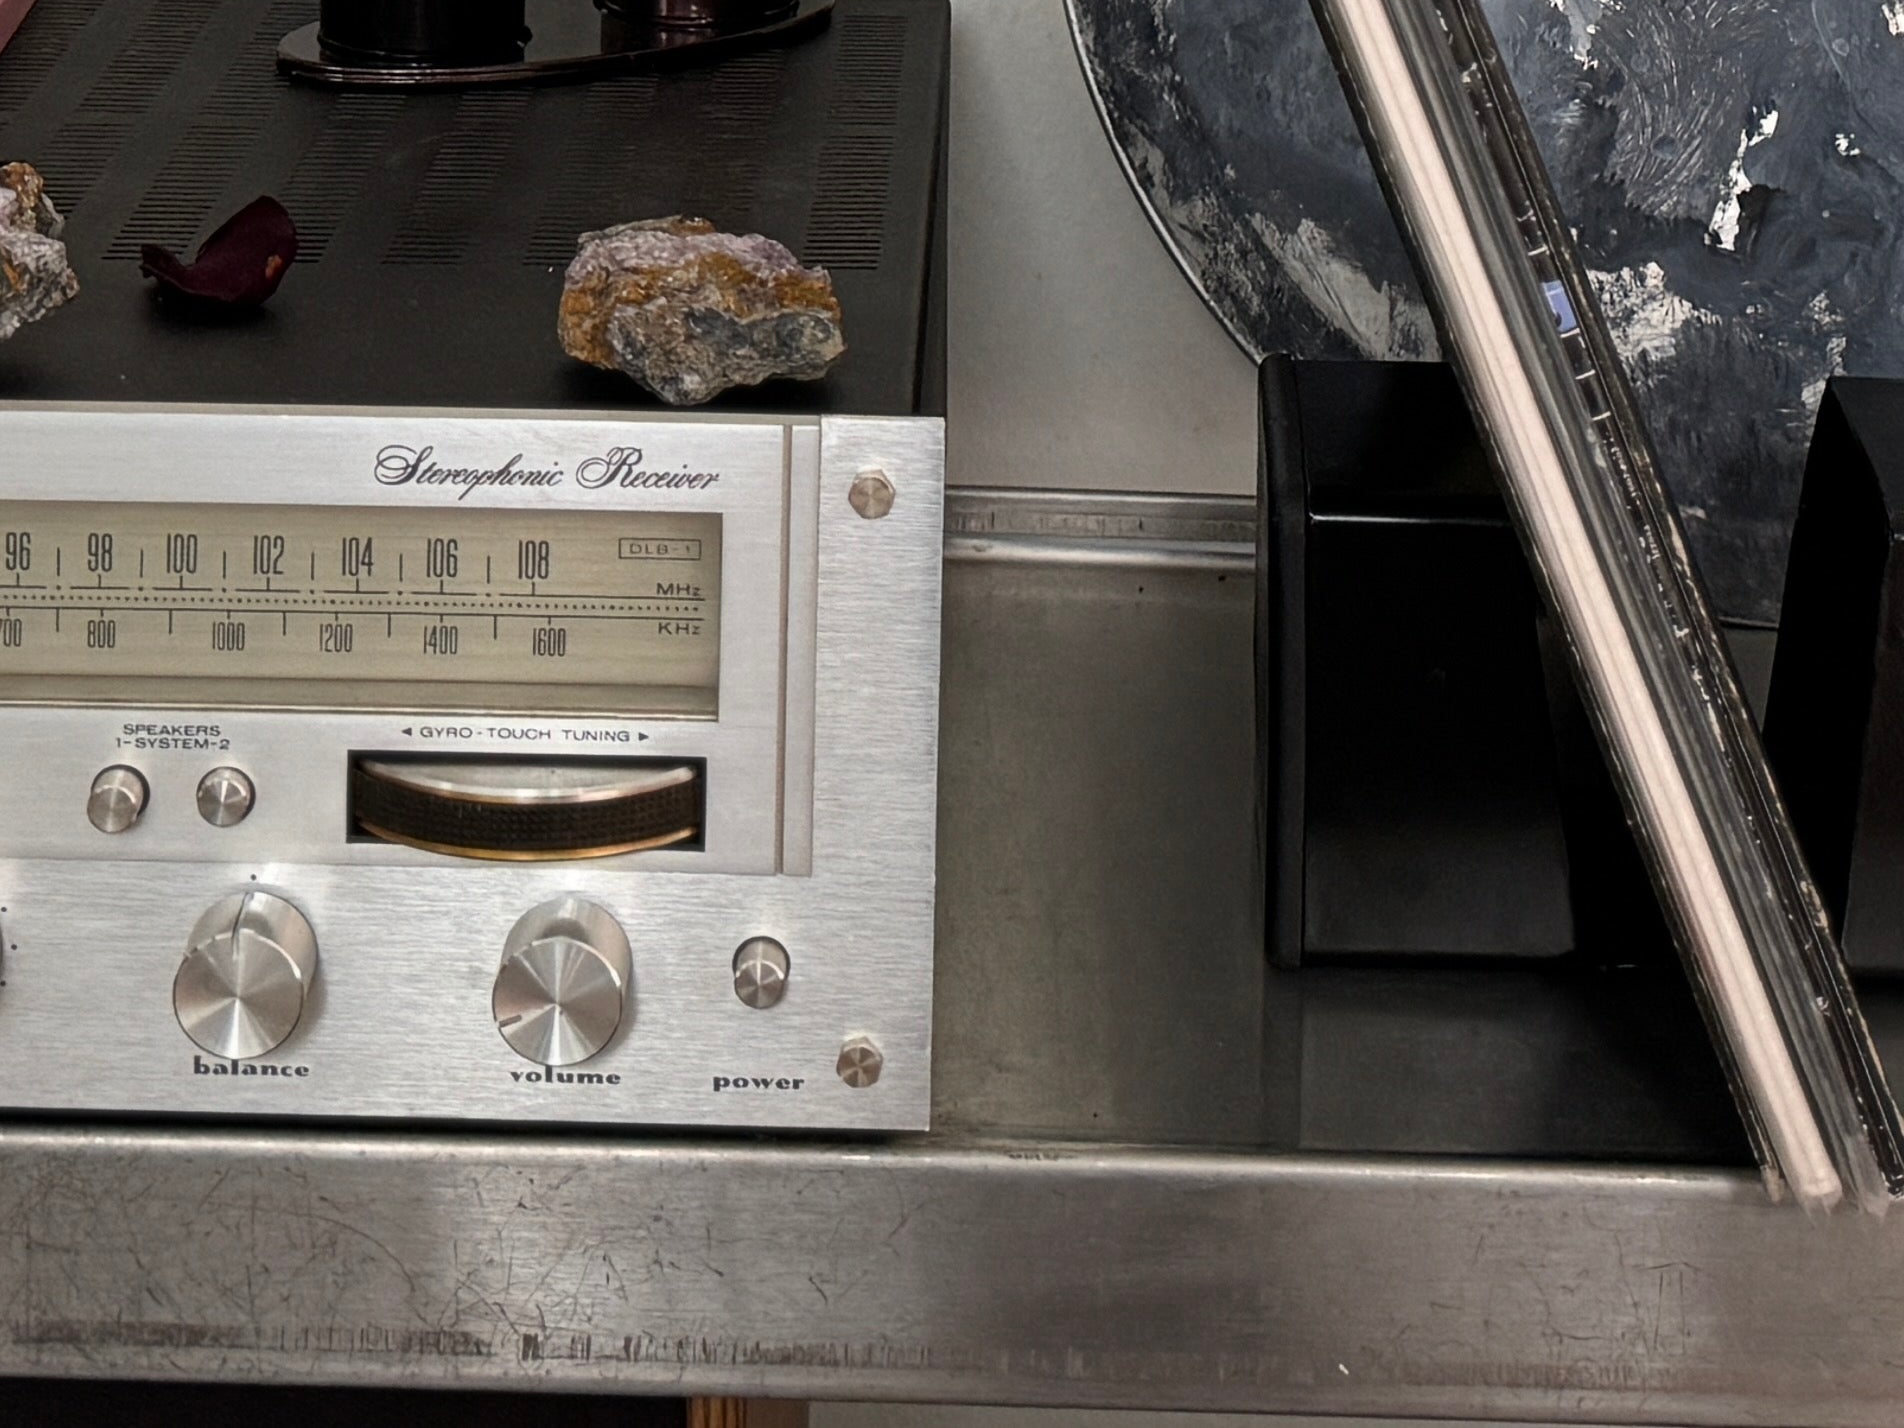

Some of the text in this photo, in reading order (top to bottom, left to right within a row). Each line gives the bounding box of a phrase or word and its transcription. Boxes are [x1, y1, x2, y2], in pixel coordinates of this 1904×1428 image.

[374, 444, 720, 501] Stereophonic Receiver
[5, 531, 31, 572] 96
[87, 532, 114, 573] 98
[166, 533, 198, 574] 100
[253, 534, 285, 576] 102
[341, 537, 374, 578] 104
[426, 538, 459, 578] 106
[518, 540, 550, 580] 108
[655, 582, 701, 598] MHz
[87, 619, 116, 649] 800
[212, 621, 246, 651] 1000
[319, 623, 353, 653] 1200
[423, 626, 458, 656] 1400
[532, 627, 566, 658] 1600
[657, 622, 701, 637] KHz
[122, 723, 222, 738] SPEAKERS
[560, 729, 632, 744] TUNING
[192, 1055, 310, 1078] balance
[509, 1064, 622, 1085] volume
[711, 1075, 806, 1093] power
